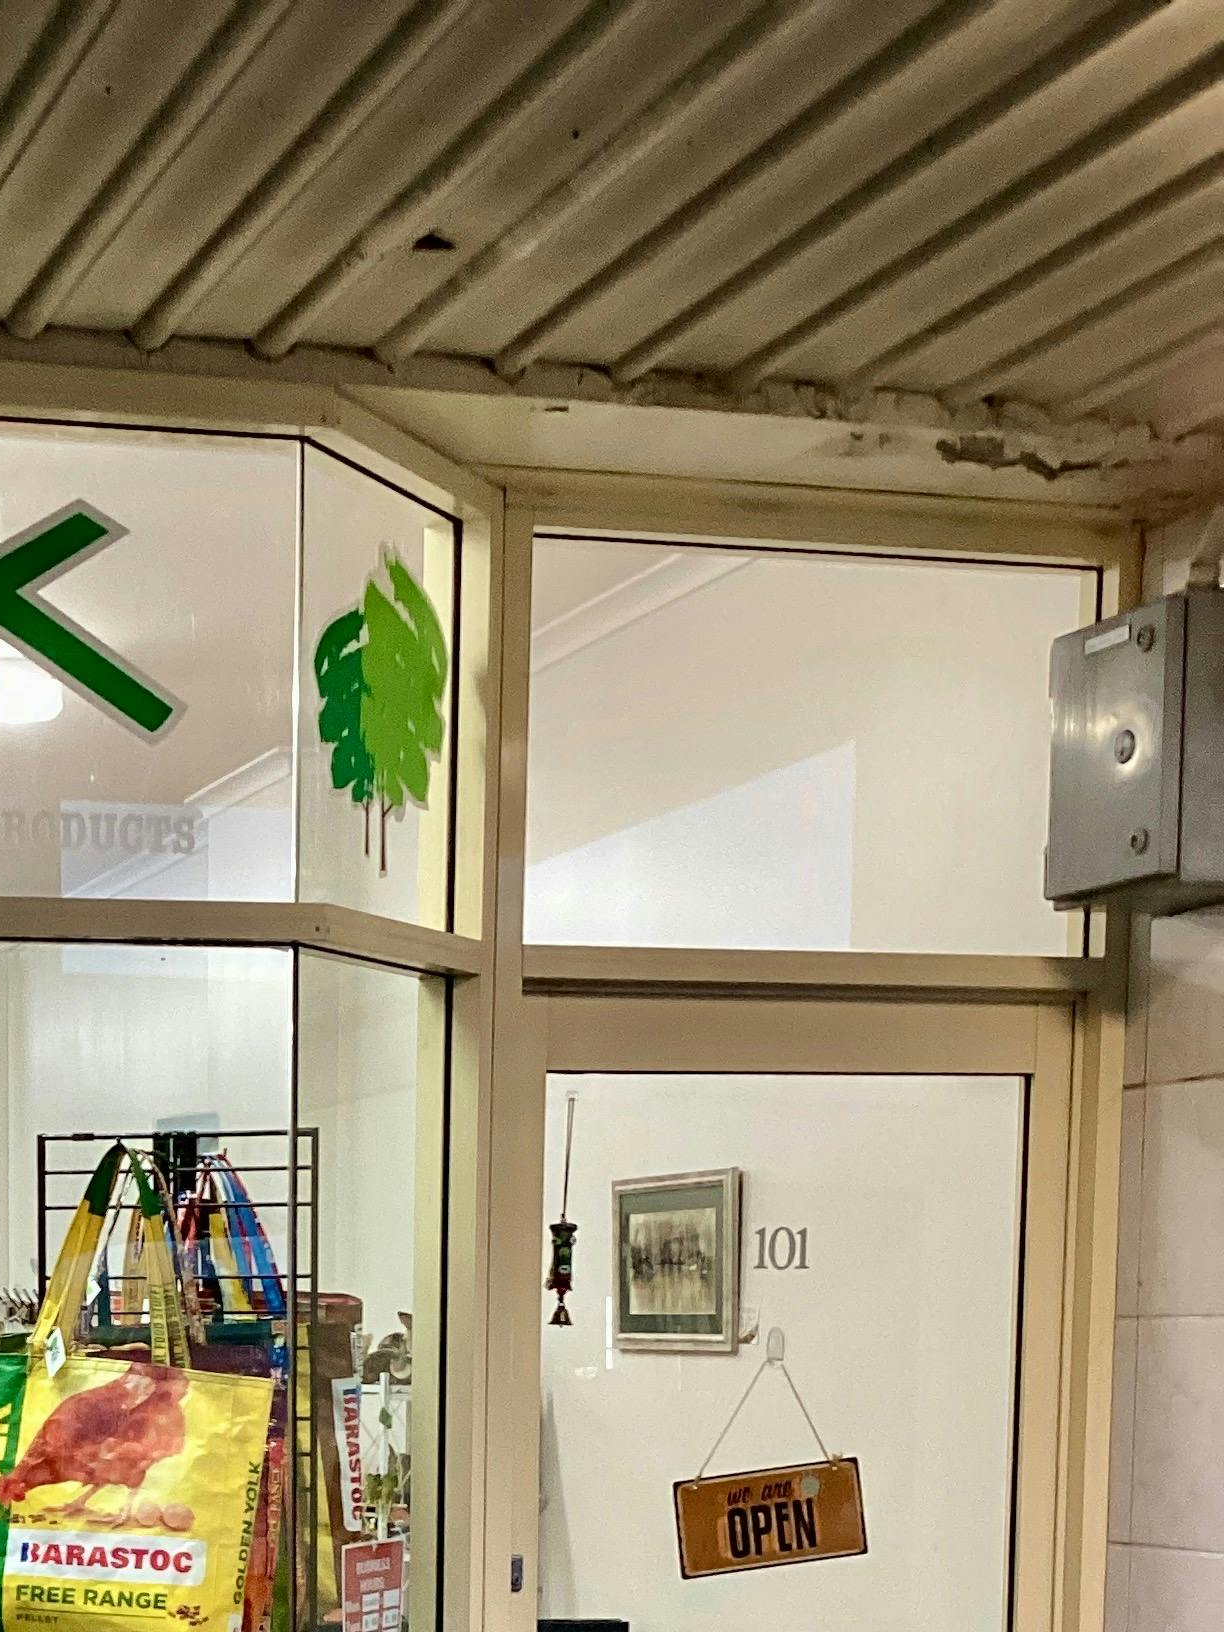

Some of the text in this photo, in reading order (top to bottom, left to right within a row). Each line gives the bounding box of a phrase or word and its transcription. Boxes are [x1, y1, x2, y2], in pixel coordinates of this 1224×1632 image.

[752, 1225, 811, 1271] 101
[727, 1479, 793, 1506] we are
[233, 1519, 254, 1605] GOLDEN
[244, 1460, 261, 1514] YOLK
[727, 1497, 818, 1559] OPEN
[20, 1541, 194, 1574] BARASTOC
[16, 1583, 169, 1611] FREE RANGE
